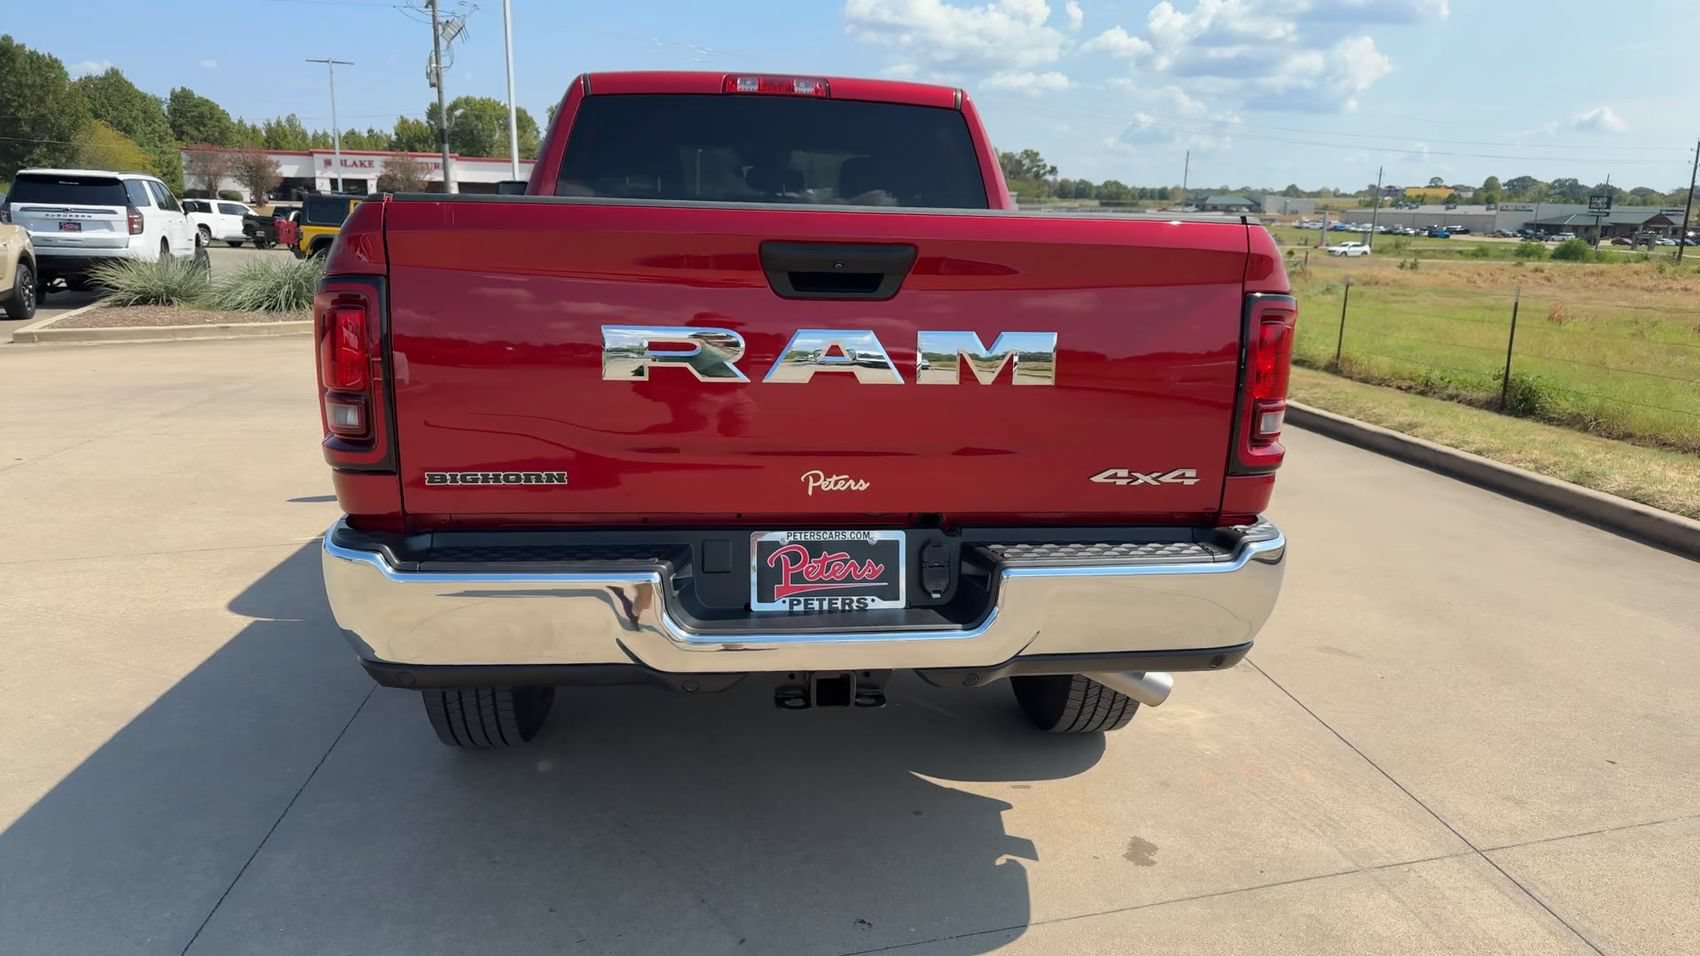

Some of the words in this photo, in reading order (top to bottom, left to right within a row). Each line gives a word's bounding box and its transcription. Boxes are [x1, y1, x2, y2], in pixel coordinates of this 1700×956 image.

[601, 324, 1058, 386] RAM
[425, 472, 568, 486] BIGHORN
[801, 470, 870, 496] Peters
[1089, 468, 1200, 486] 4x4
[786, 531, 871, 541] PETERSCARS.COM
[767, 544, 885, 588] Peters
[788, 597, 870, 612] PETERS
